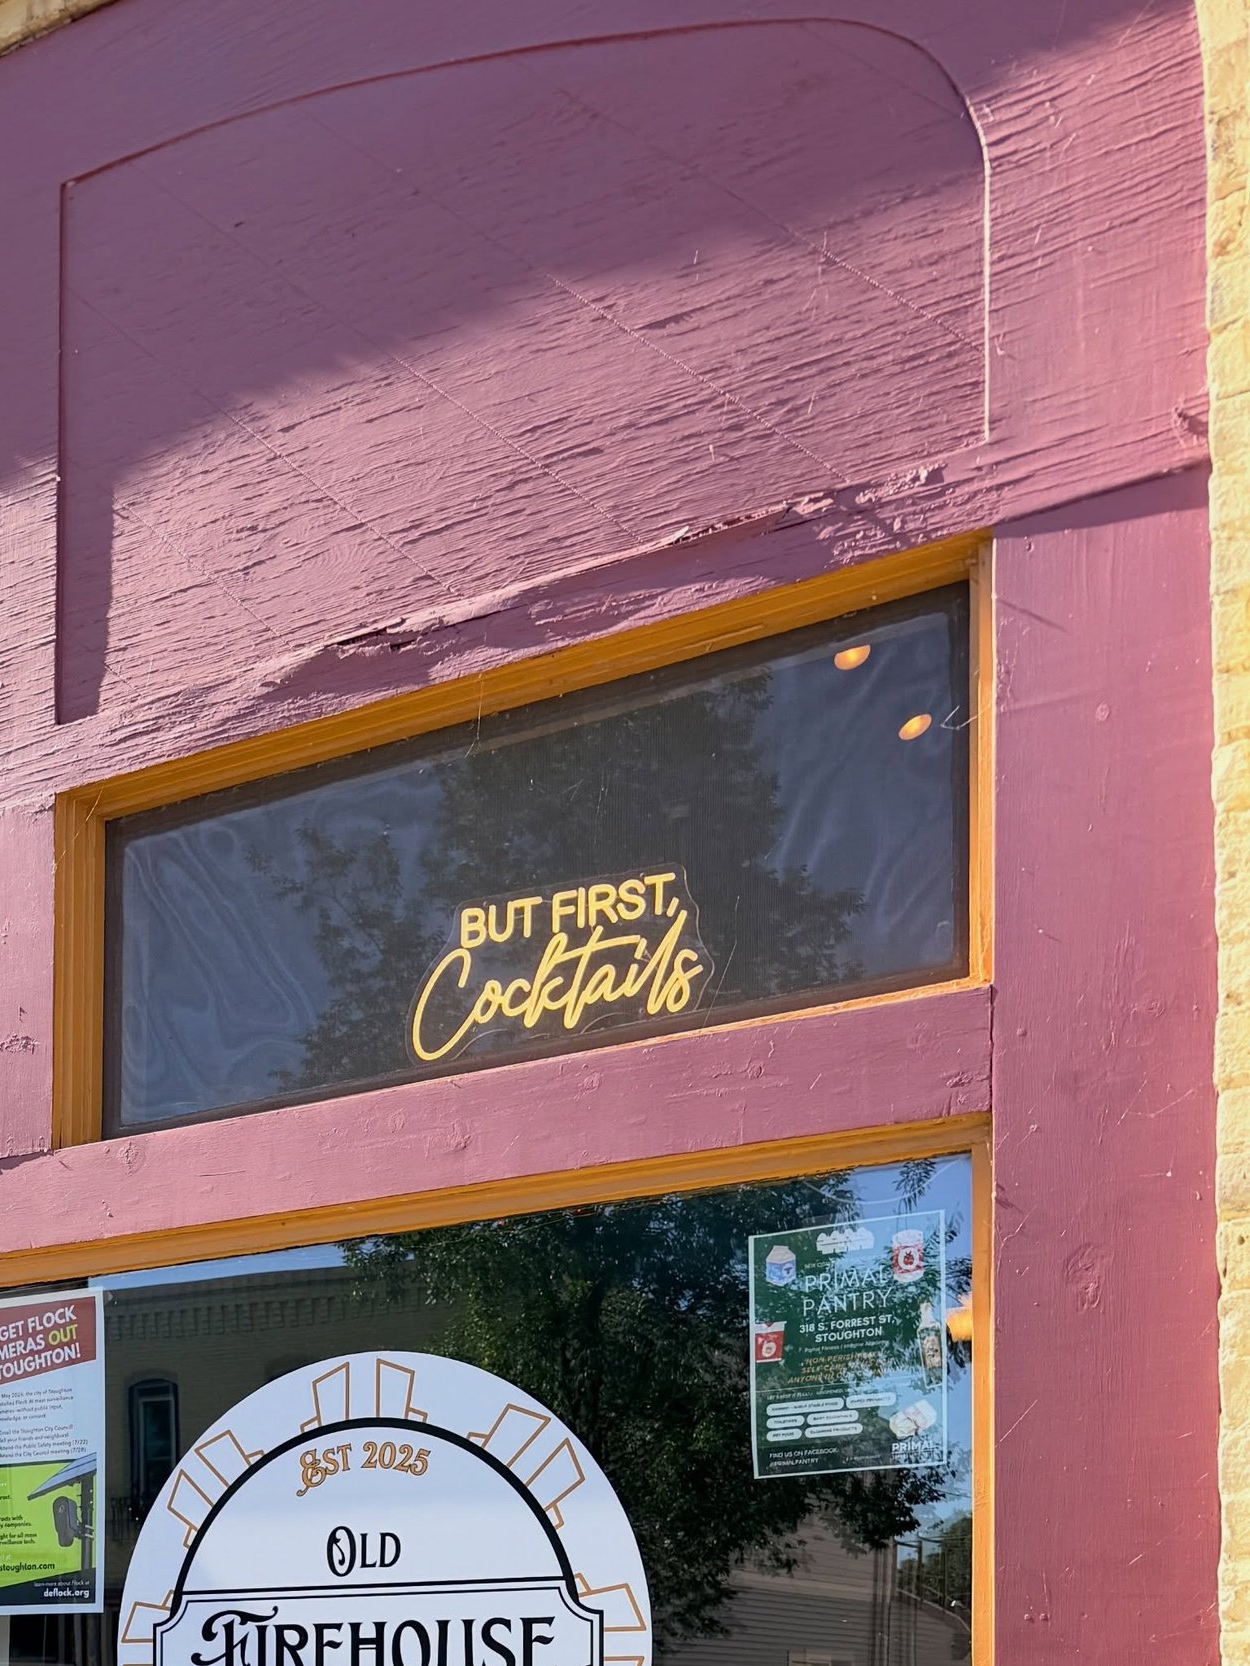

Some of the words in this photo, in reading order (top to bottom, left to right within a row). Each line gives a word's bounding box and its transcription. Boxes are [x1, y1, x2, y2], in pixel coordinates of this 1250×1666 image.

[461, 896, 543, 949] BUT
[552, 872, 680, 933] FIRST,
[412, 910, 703, 1061] Cocktails
[805, 1265, 890, 1293] PRIMAL
[803, 1287, 892, 1317] PANTRY
[28, 1305, 77, 1334] FLOCK
[799, 1324, 815, 1334] 318
[830, 1316, 876, 1330] FORREST
[48, 1324, 78, 1346] OUT
[815, 1326, 883, 1343] STOUGHTON
[360, 1441, 431, 1477] 2025
[43, 1588, 90, 1598] deflock.org
